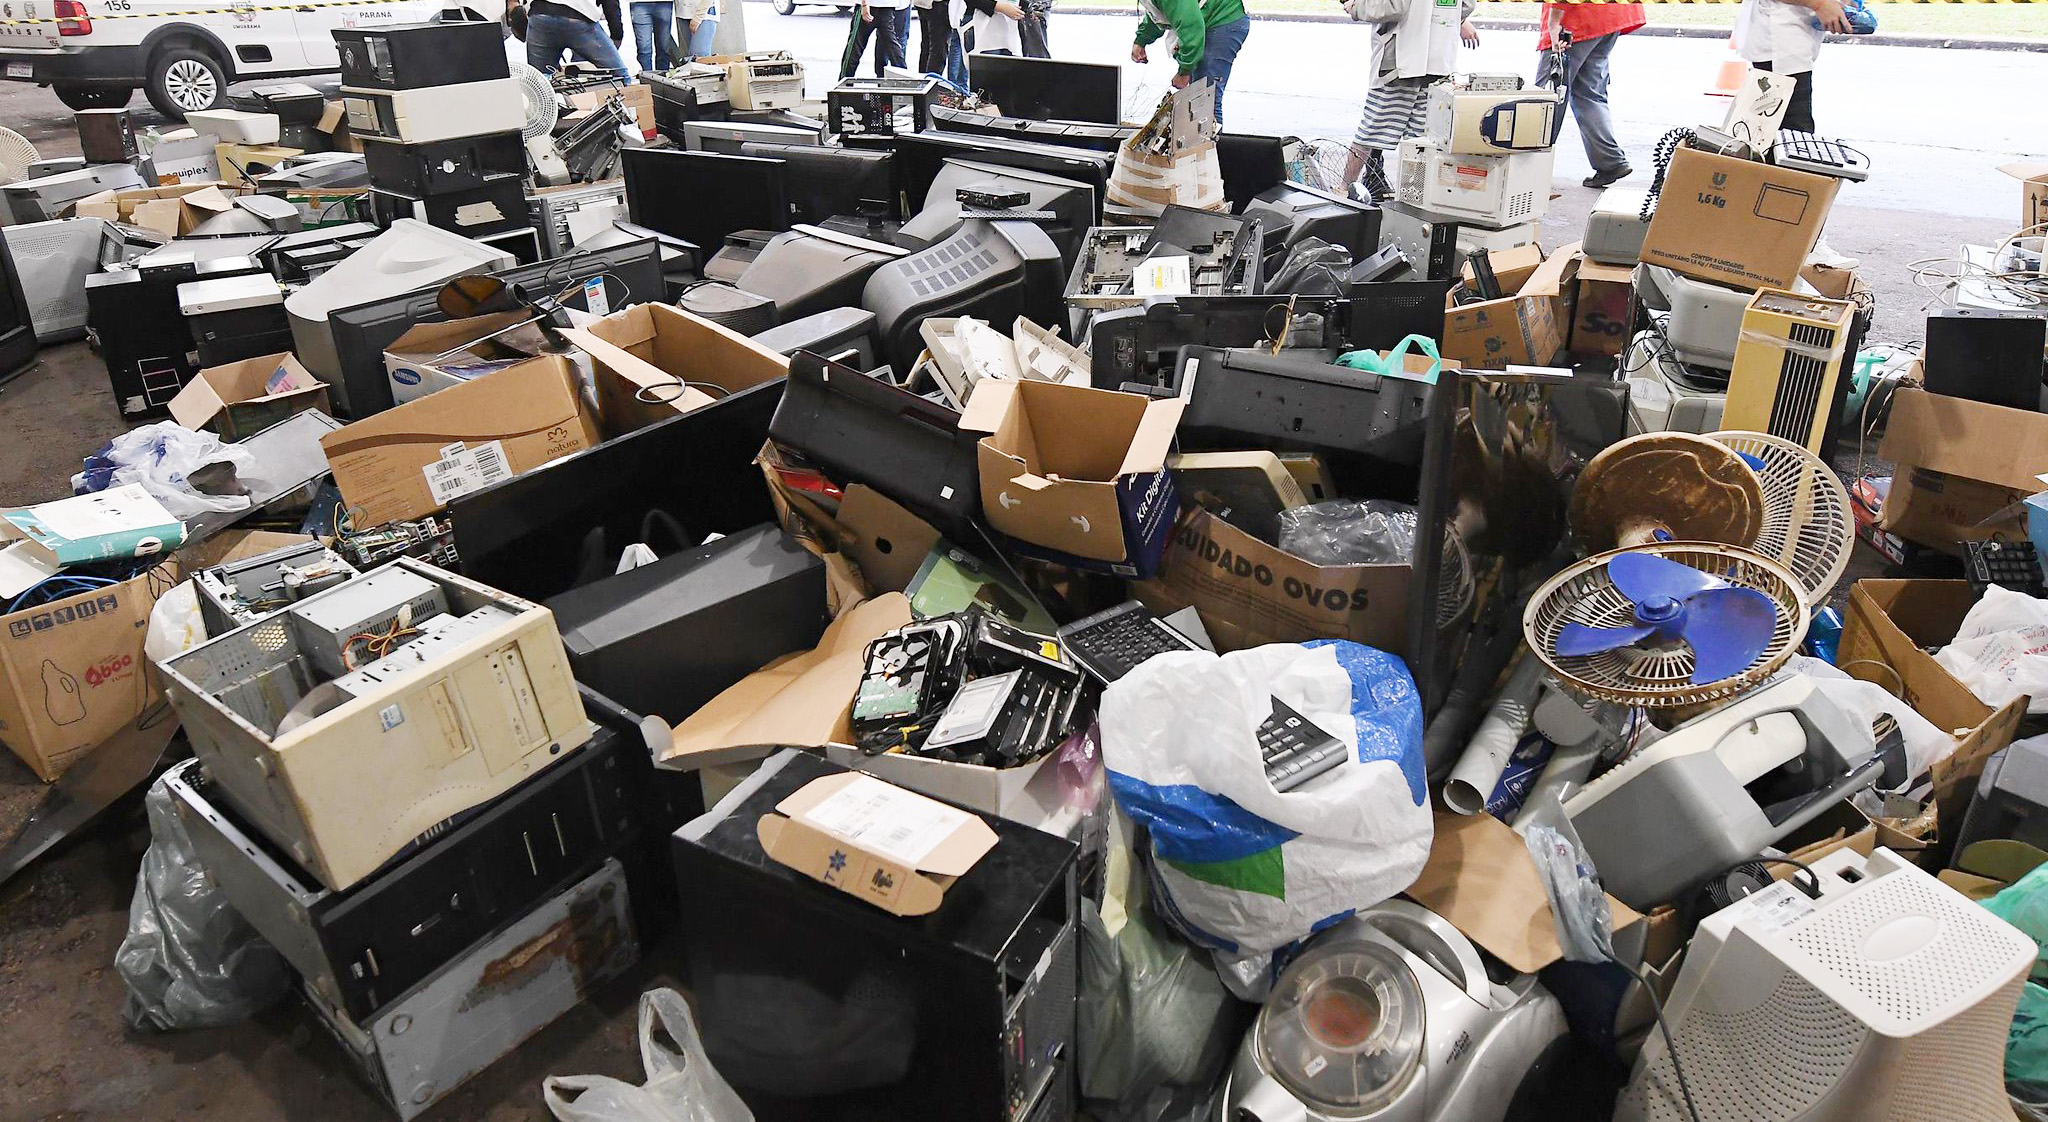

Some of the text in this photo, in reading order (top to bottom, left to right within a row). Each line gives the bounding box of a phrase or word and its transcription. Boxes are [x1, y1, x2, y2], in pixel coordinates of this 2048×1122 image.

[104, 0, 131, 11] 156
[1697, 192, 1727, 208] 1,6 Kg
[1717, 259, 1745, 270] UNIDADES
[1746, 272, 1763, 281] TOTAL
[546, 440, 579, 455] natura
[1136, 501, 1149, 523] Kit
[1145, 465, 1166, 506] Digital
[1283, 576, 1369, 612] OVOS
